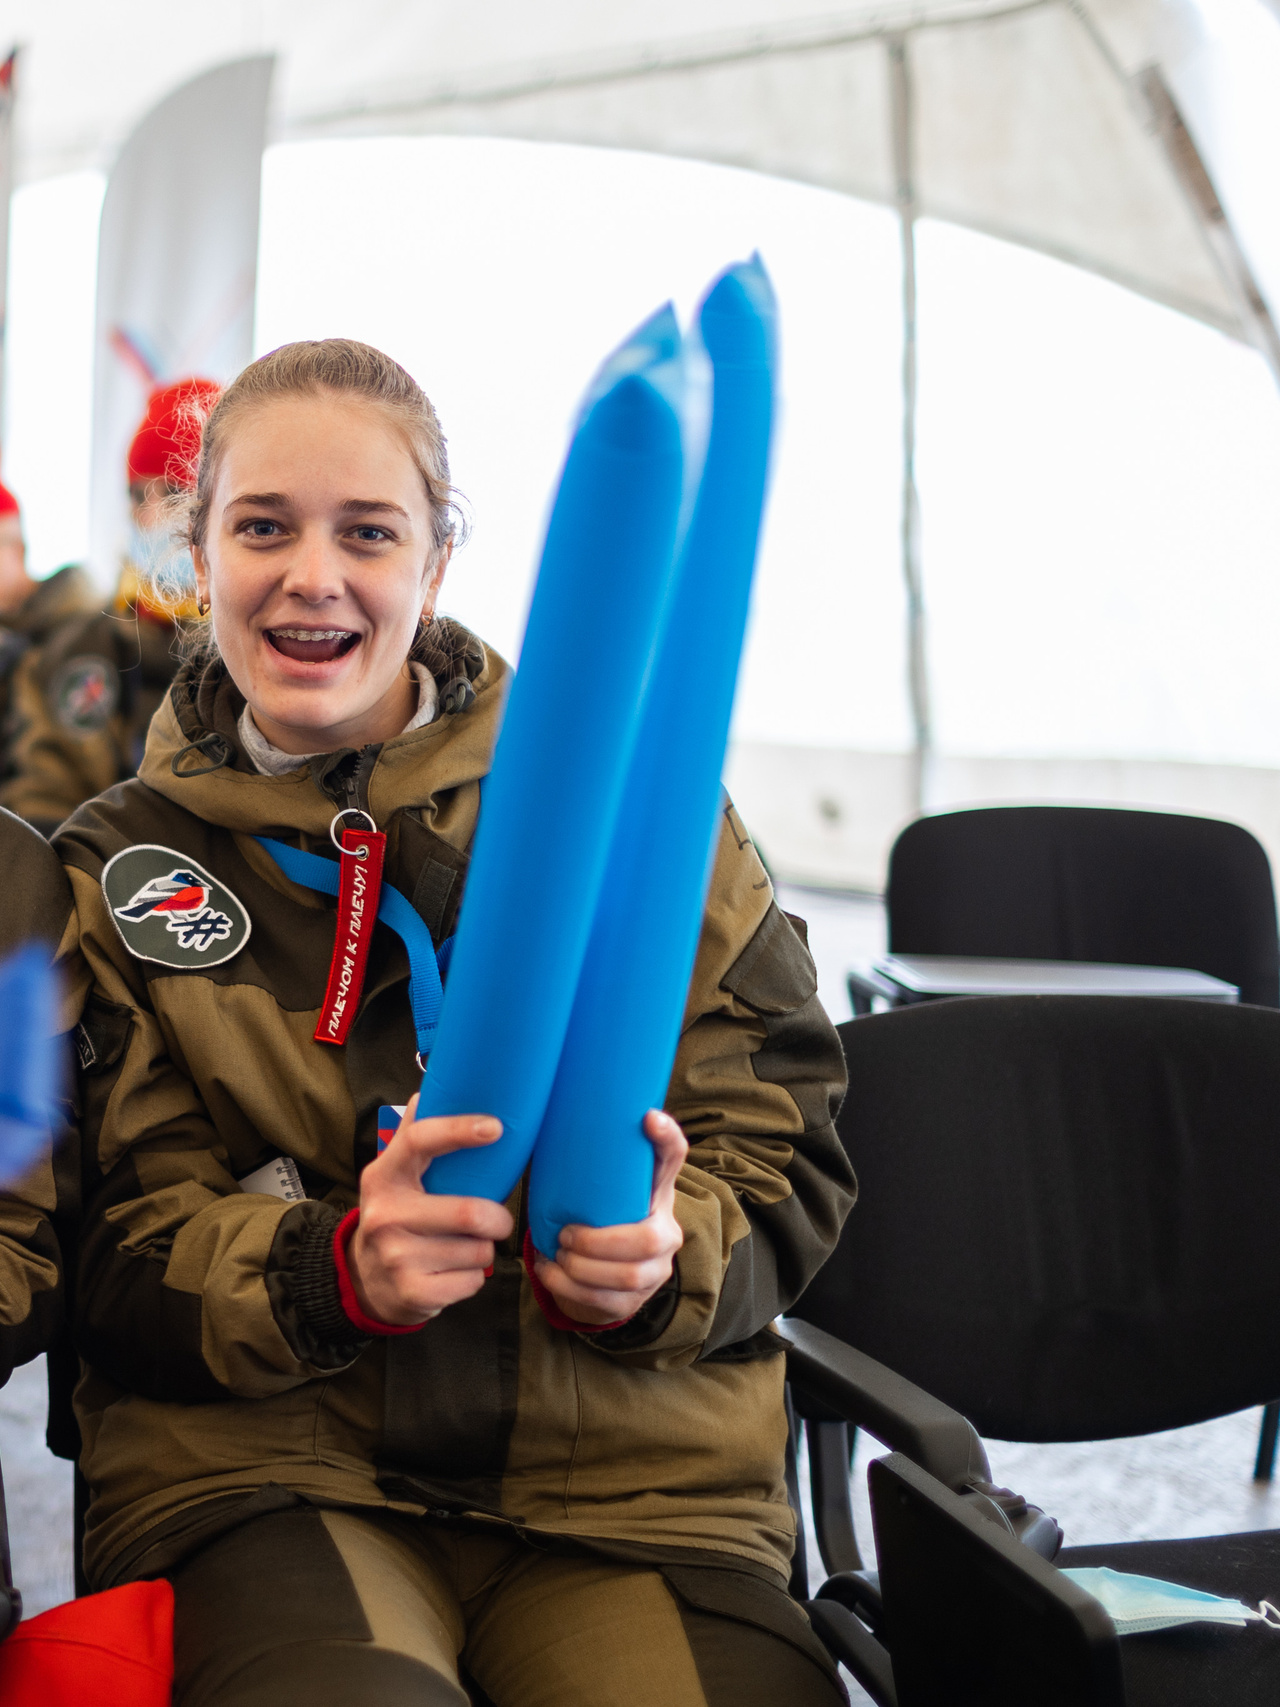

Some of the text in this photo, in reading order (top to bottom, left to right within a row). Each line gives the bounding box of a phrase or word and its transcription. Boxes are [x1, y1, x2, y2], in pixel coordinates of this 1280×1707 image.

[328, 865, 368, 1037] ПЛЕЧОМ К ПЛЕЧУ!
